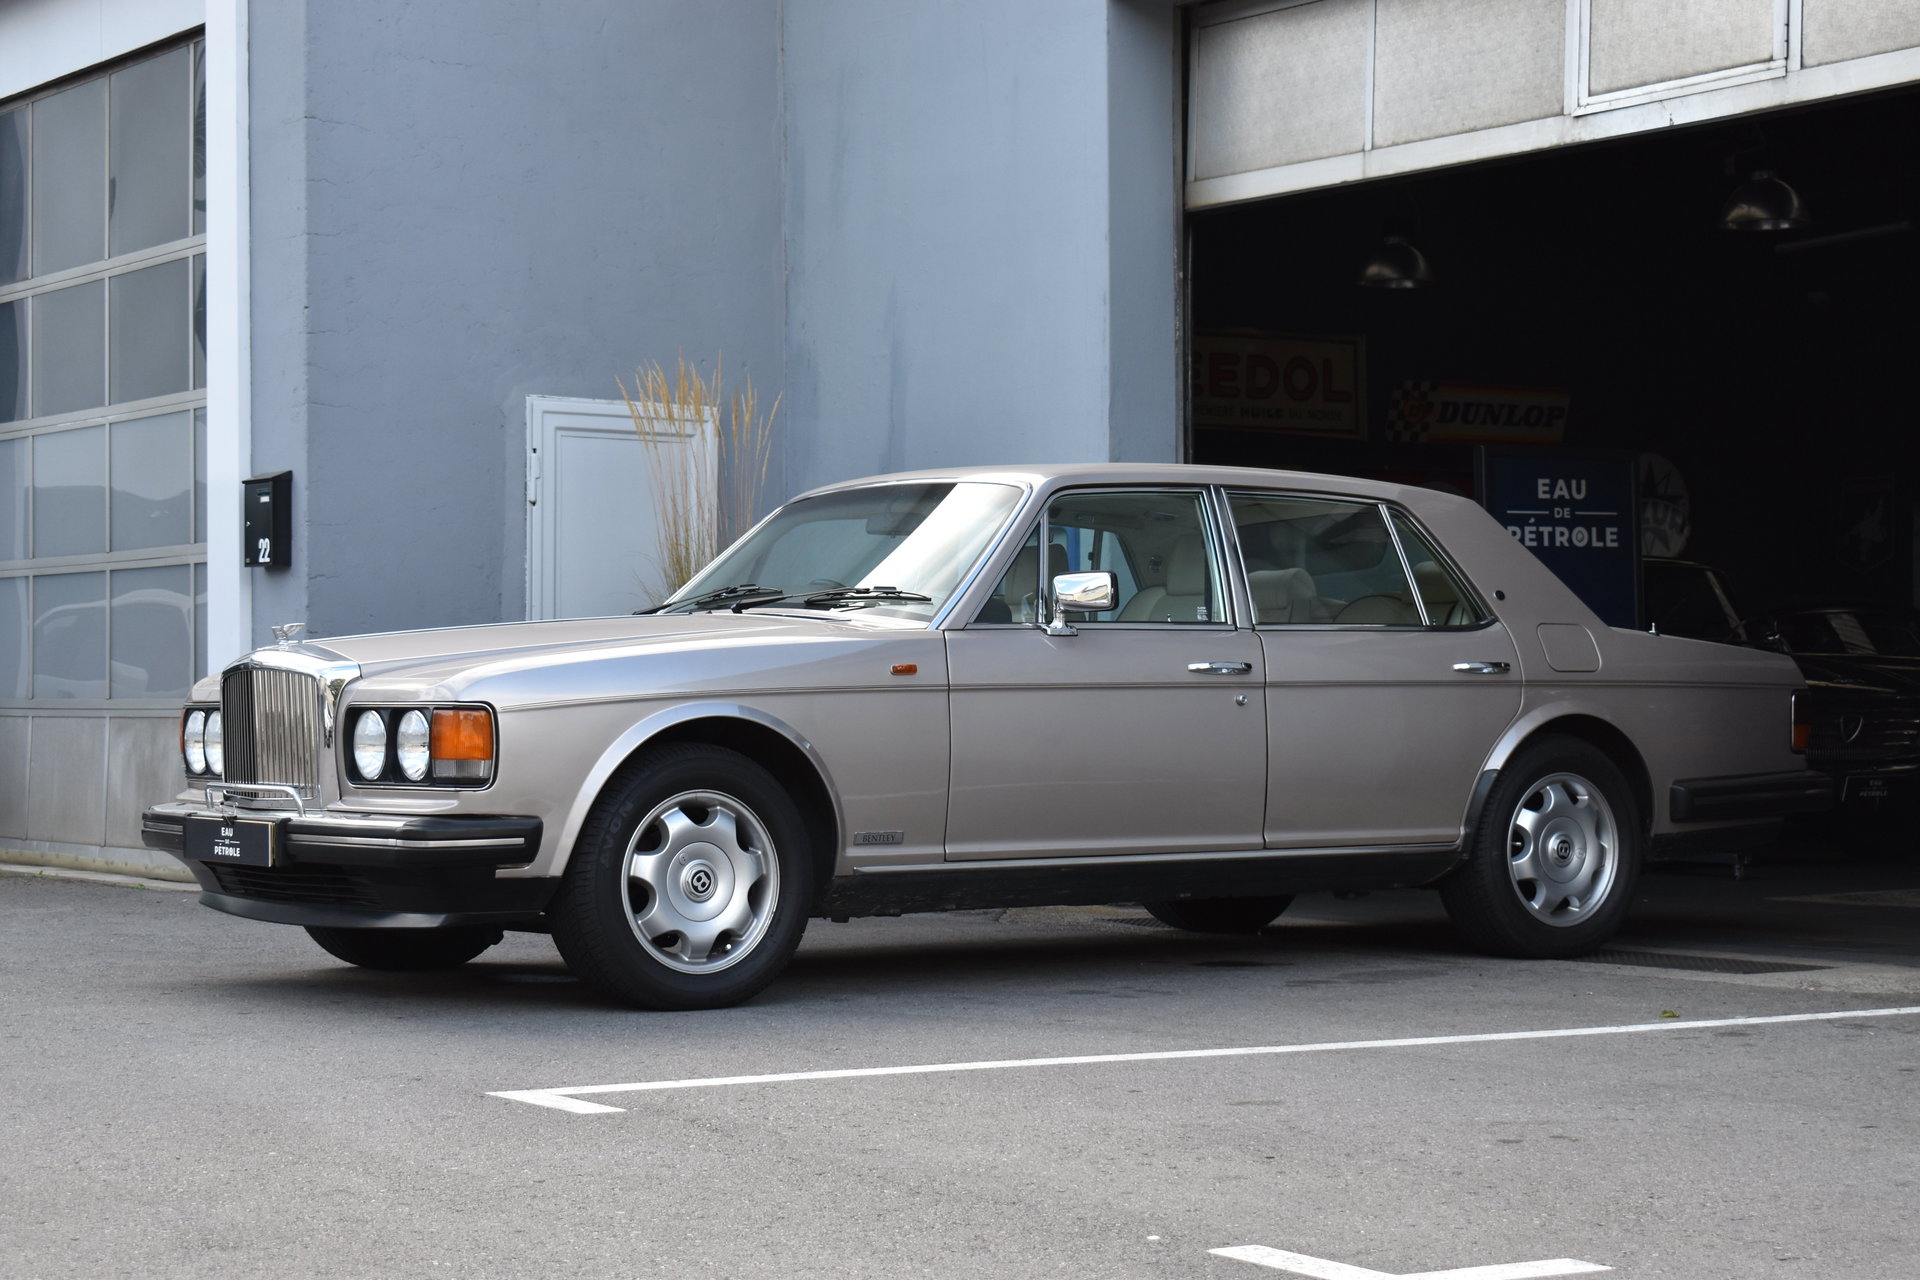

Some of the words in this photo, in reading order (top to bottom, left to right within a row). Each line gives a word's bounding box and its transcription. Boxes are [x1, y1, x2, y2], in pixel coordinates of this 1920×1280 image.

[1435, 400, 1566, 428] DUNLOP
[1537, 477, 1587, 500] EAU
[1554, 507, 1572, 519] DE
[1506, 517, 1619, 547] PÉTROLE
[258, 538, 270, 563] 22
[221, 827, 234, 838] EAU
[862, 834, 896, 843] BENTLEY
[214, 843, 241, 857] PÉTROLE
